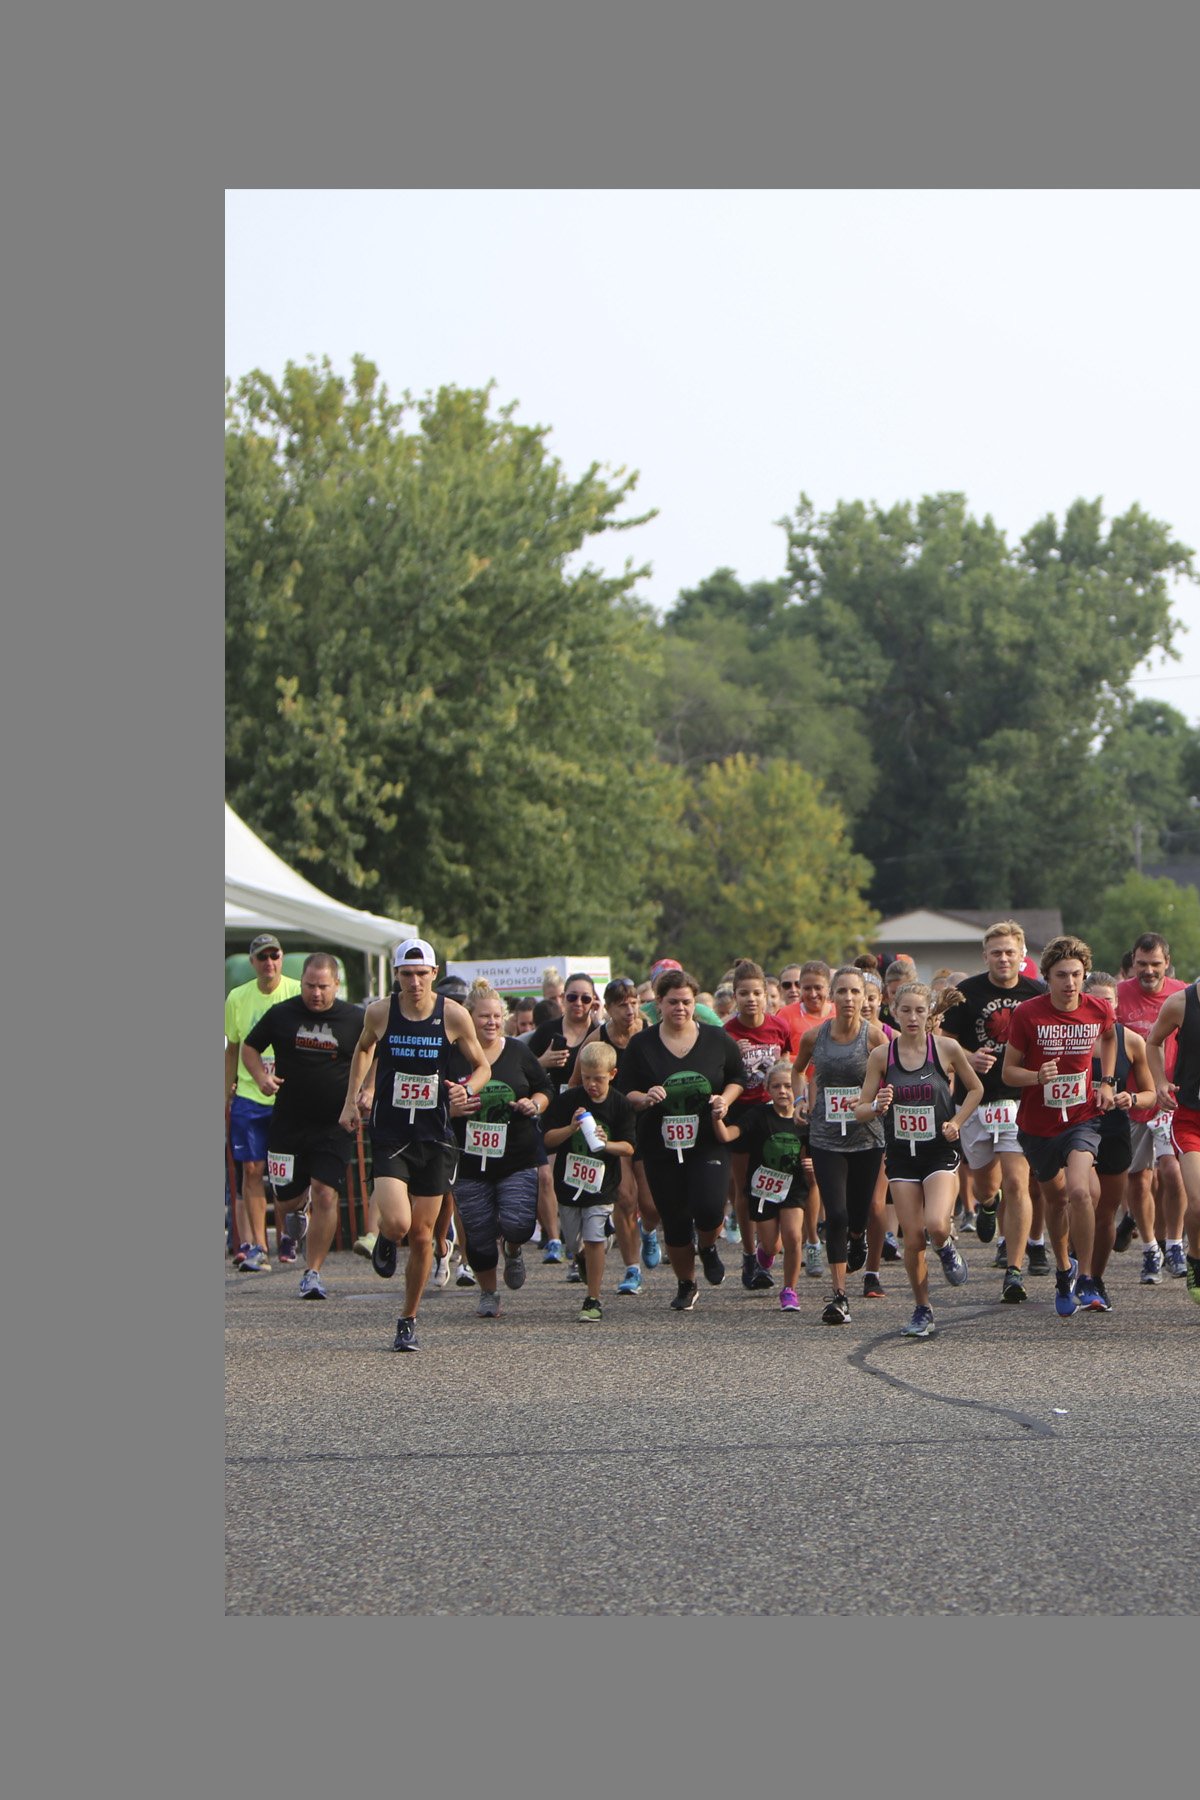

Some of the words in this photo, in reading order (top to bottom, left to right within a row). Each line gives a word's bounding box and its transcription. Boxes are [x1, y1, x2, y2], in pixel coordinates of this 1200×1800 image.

[476, 967, 511, 976] THANK
[515, 966, 537, 974] YOU
[982, 998, 1002, 1018] HOT
[1037, 1023, 1101, 1039] WISCONSIN
[389, 1034, 443, 1046] COLLEGEVILLE
[1065, 1038, 1095, 1046] COUNT
[391, 1047, 416, 1057] TRACK
[418, 1049, 439, 1058] CLUB
[1052, 1074, 1084, 1082] EPPERFEST
[401, 1083, 430, 1099] 554
[826, 1087, 860, 1095] PEPPERFEST
[1052, 1082, 1080, 1099] 624
[831, 1096, 849, 1112] 54
[896, 1106, 932, 1114] PEPPERFEST
[900, 1115, 928, 1131] 630
[985, 1107, 1010, 1123] 641
[469, 1122, 506, 1132] PEPPERFEST
[667, 1124, 694, 1140] 583
[473, 1130, 500, 1148] 588
[572, 1162, 597, 1184] 589
[758, 1167, 791, 1181] PEPPERFEST
[756, 1175, 784, 1194] 585
